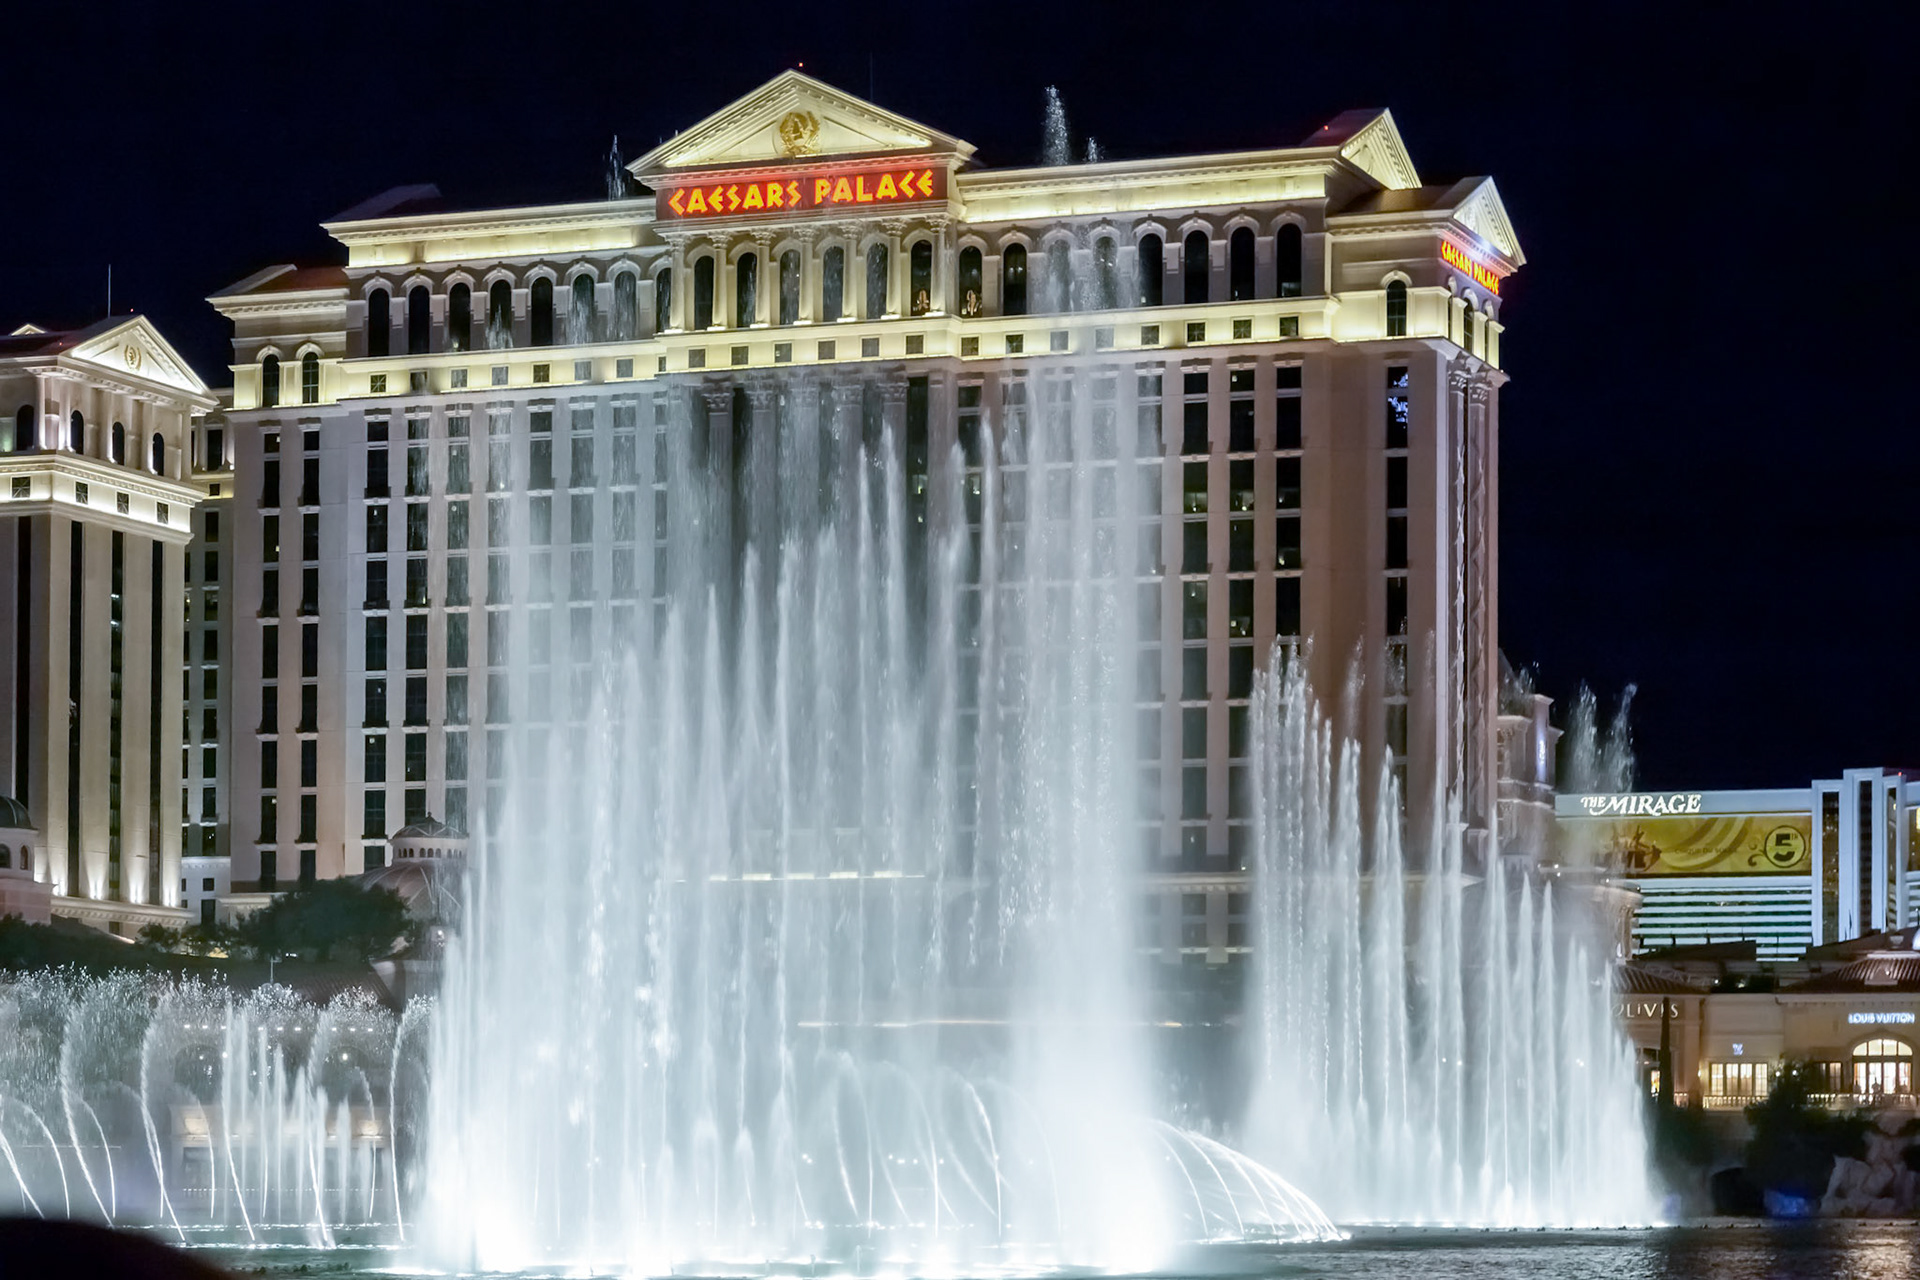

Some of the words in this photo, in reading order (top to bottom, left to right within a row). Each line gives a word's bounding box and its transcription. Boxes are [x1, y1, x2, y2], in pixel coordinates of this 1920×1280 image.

[668, 181, 802, 216] CAESARS
[814, 169, 933, 205] PALACE
[1589, 794, 1702, 816] MIRAGE
[1875, 1012, 1915, 1024] VUITTON
